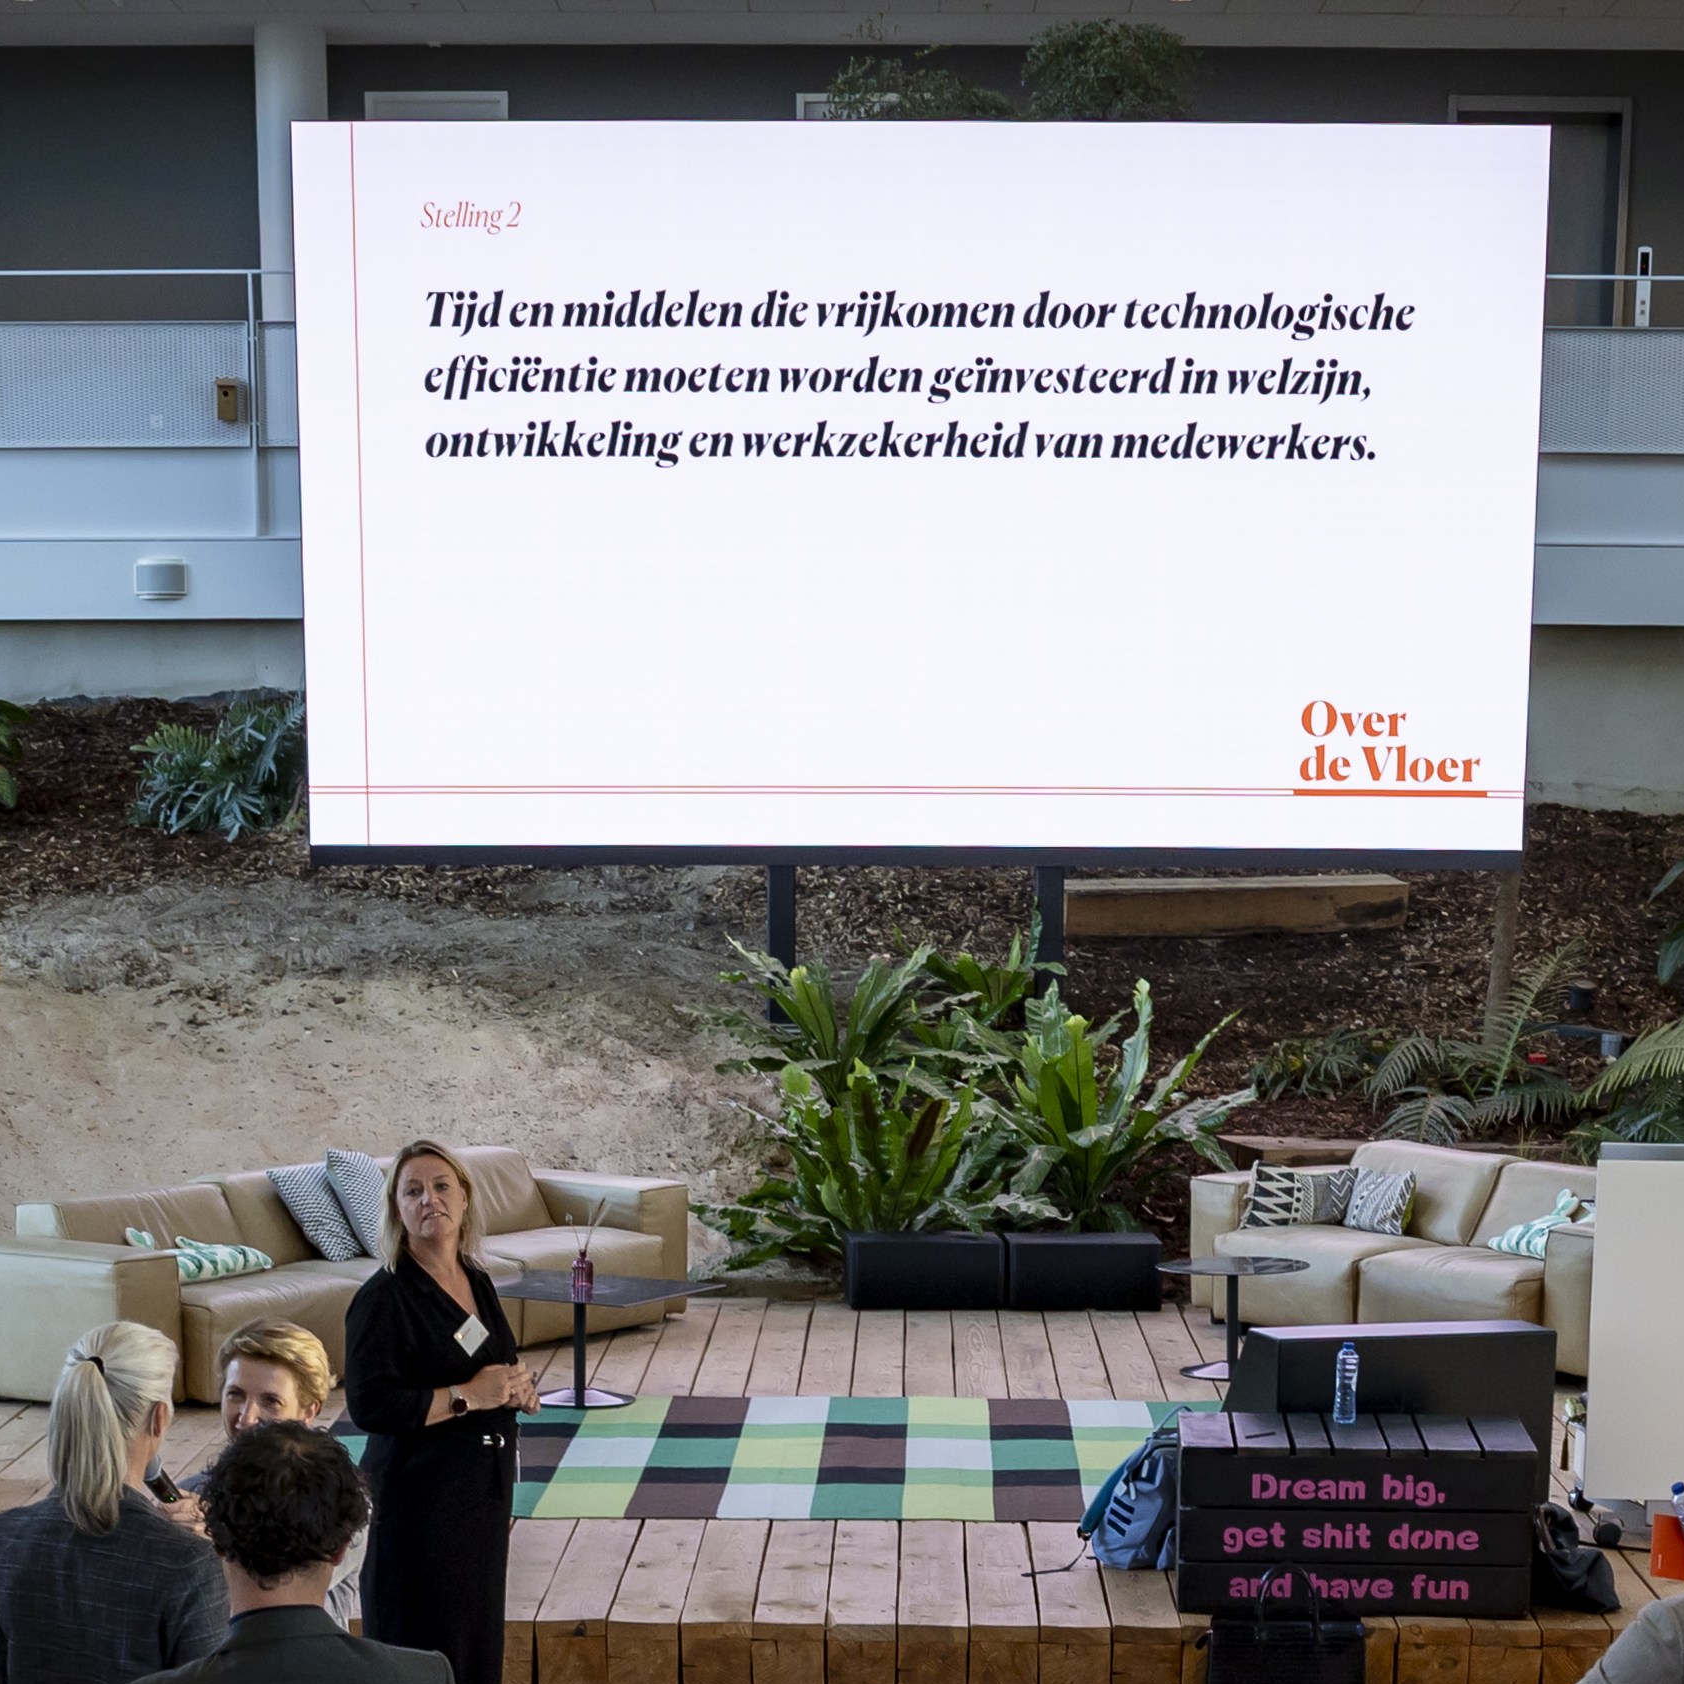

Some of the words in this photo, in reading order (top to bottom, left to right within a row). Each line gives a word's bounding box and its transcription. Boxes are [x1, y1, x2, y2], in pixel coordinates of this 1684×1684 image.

[420, 201, 503, 235] Stelling
[505, 201, 522, 228] 2
[425, 289, 504, 337] Tijd
[509, 301, 554, 328] en
[562, 289, 743, 328] middelen
[750, 289, 809, 328] die
[816, 290, 1015, 337] vrijkomen
[1022, 290, 1117, 329] door
[1123, 291, 1416, 341] technologische
[424, 354, 617, 401] efficiëntie
[623, 363, 770, 393] moeten
[779, 355, 923, 393] worden
[927, 356, 1176, 404] geïnvesteerd
[1179, 357, 1218, 394] in
[1227, 357, 1371, 404] welzijn,
[425, 420, 683, 468] ontwikkeling
[689, 432, 734, 458] en
[742, 420, 1030, 459] werkzekerheid
[1035, 433, 1103, 459] van
[1110, 421, 1376, 461] medewerkers.
[1301, 700, 1407, 737] Over
[1299, 744, 1351, 782] de
[1361, 745, 1481, 783] Vloer
[1251, 1473, 1367, 1500] Dream
[1382, 1473, 1446, 1507] big,
[1223, 1522, 1286, 1554] get
[1302, 1523, 1371, 1549] shit
[1388, 1524, 1480, 1551] done
[1229, 1572, 1293, 1599] and
[1309, 1573, 1394, 1599] have
[1410, 1574, 1470, 1600] fun
